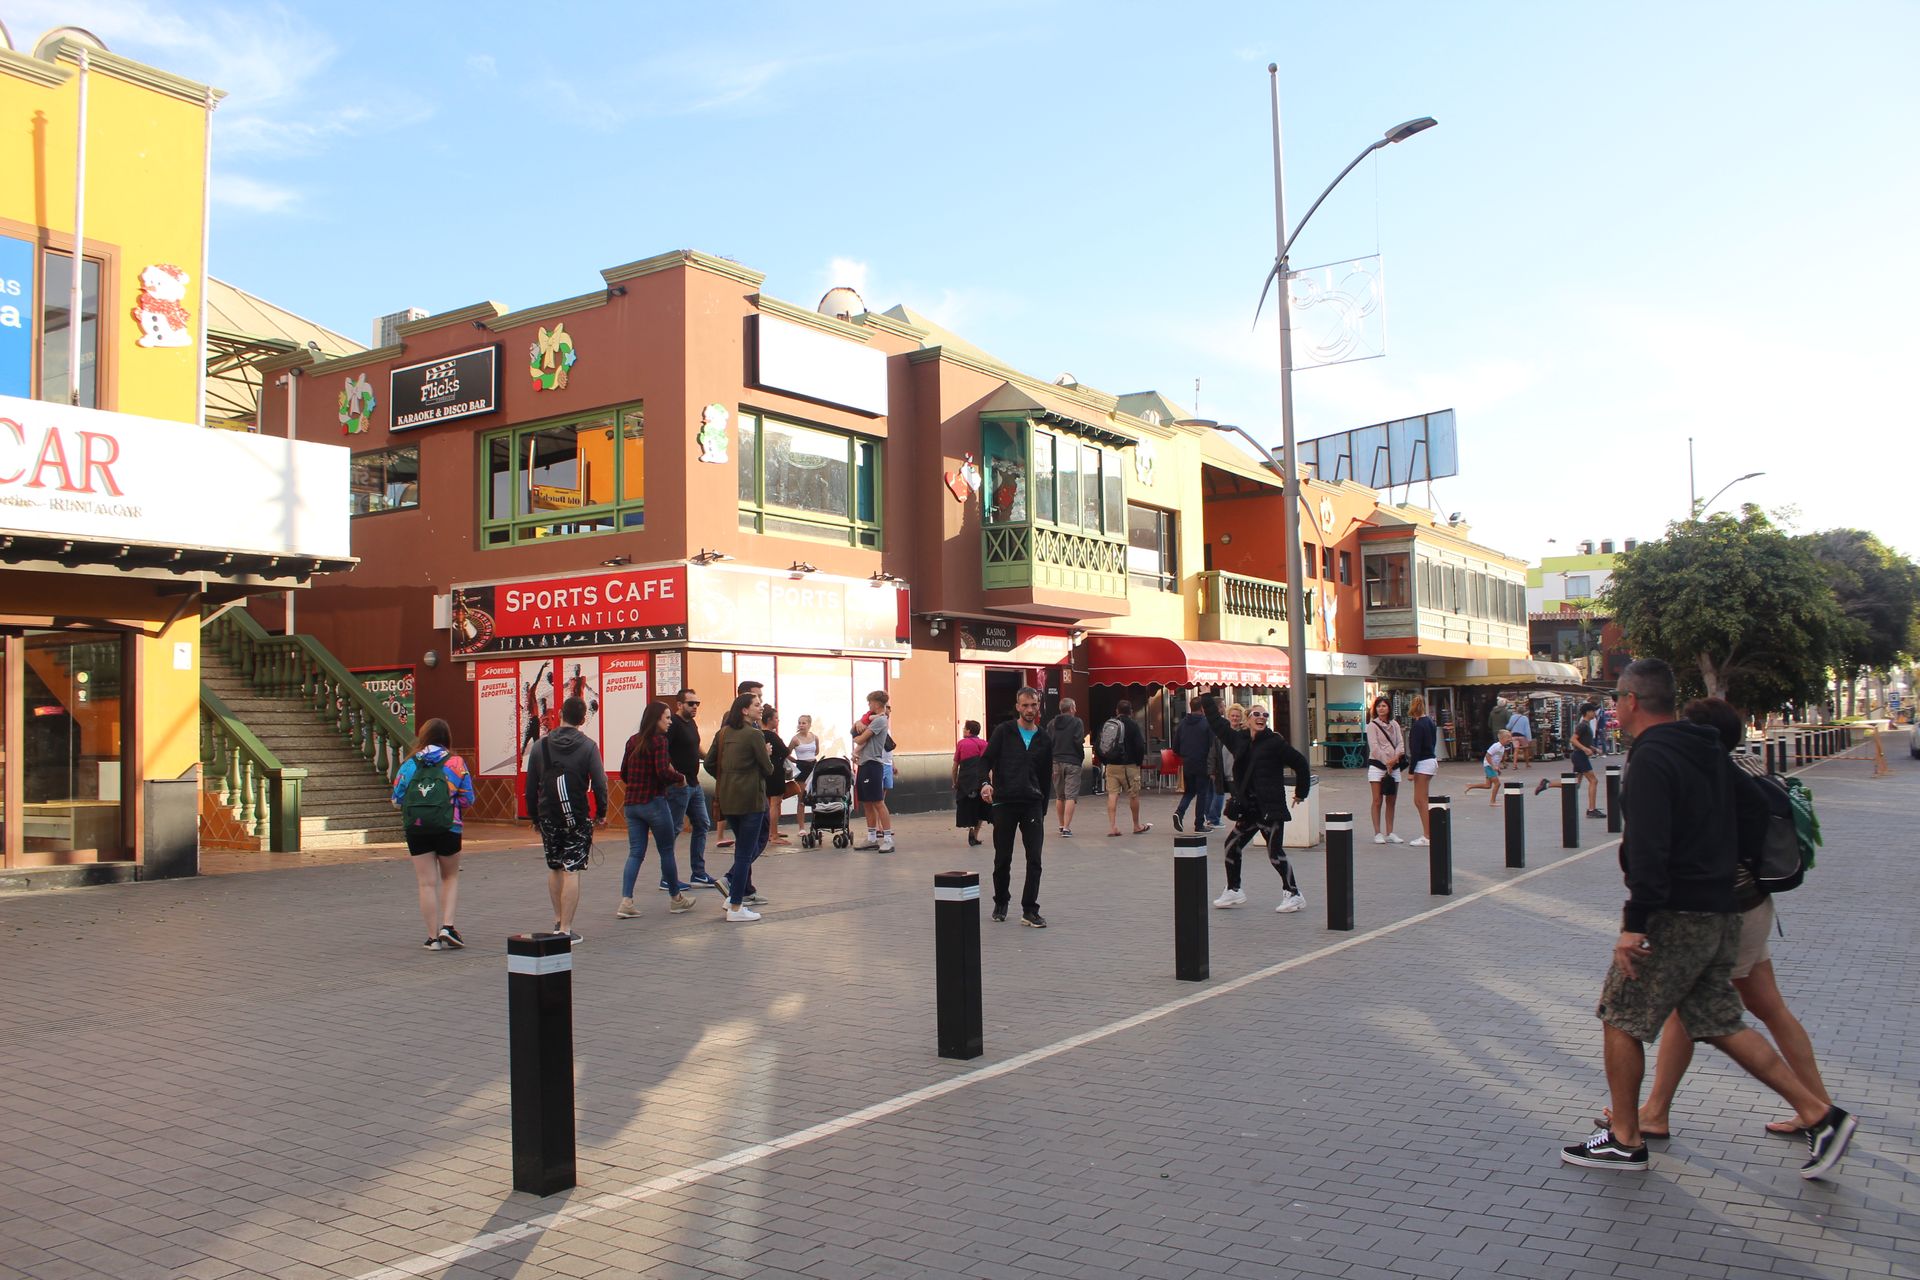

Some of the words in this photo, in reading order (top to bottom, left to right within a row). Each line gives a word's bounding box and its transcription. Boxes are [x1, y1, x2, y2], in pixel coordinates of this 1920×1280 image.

[420, 377, 460, 403] Flicks
[397, 409, 435, 426] KARAOKE
[435, 407, 442, 418] &
[443, 402, 468, 417] DISCO
[469, 399, 486, 411] BAR
[505, 585, 598, 613] SPORTS
[604, 577, 675, 604] CAFE
[755, 579, 841, 610] SPORTS
[532, 608, 640, 630] ATLANTICO
[986, 627, 1007, 637] KASINO
[606, 658, 644, 671] SPORTIUM
[481, 667, 514, 678] SPORTIUM
[482, 682, 508, 691] APUESTAS
[606, 675, 637, 686] APUESTAS
[480, 688, 514, 699] DEPORTIVAS
[605, 682, 643, 693] DEPORTIVAS
